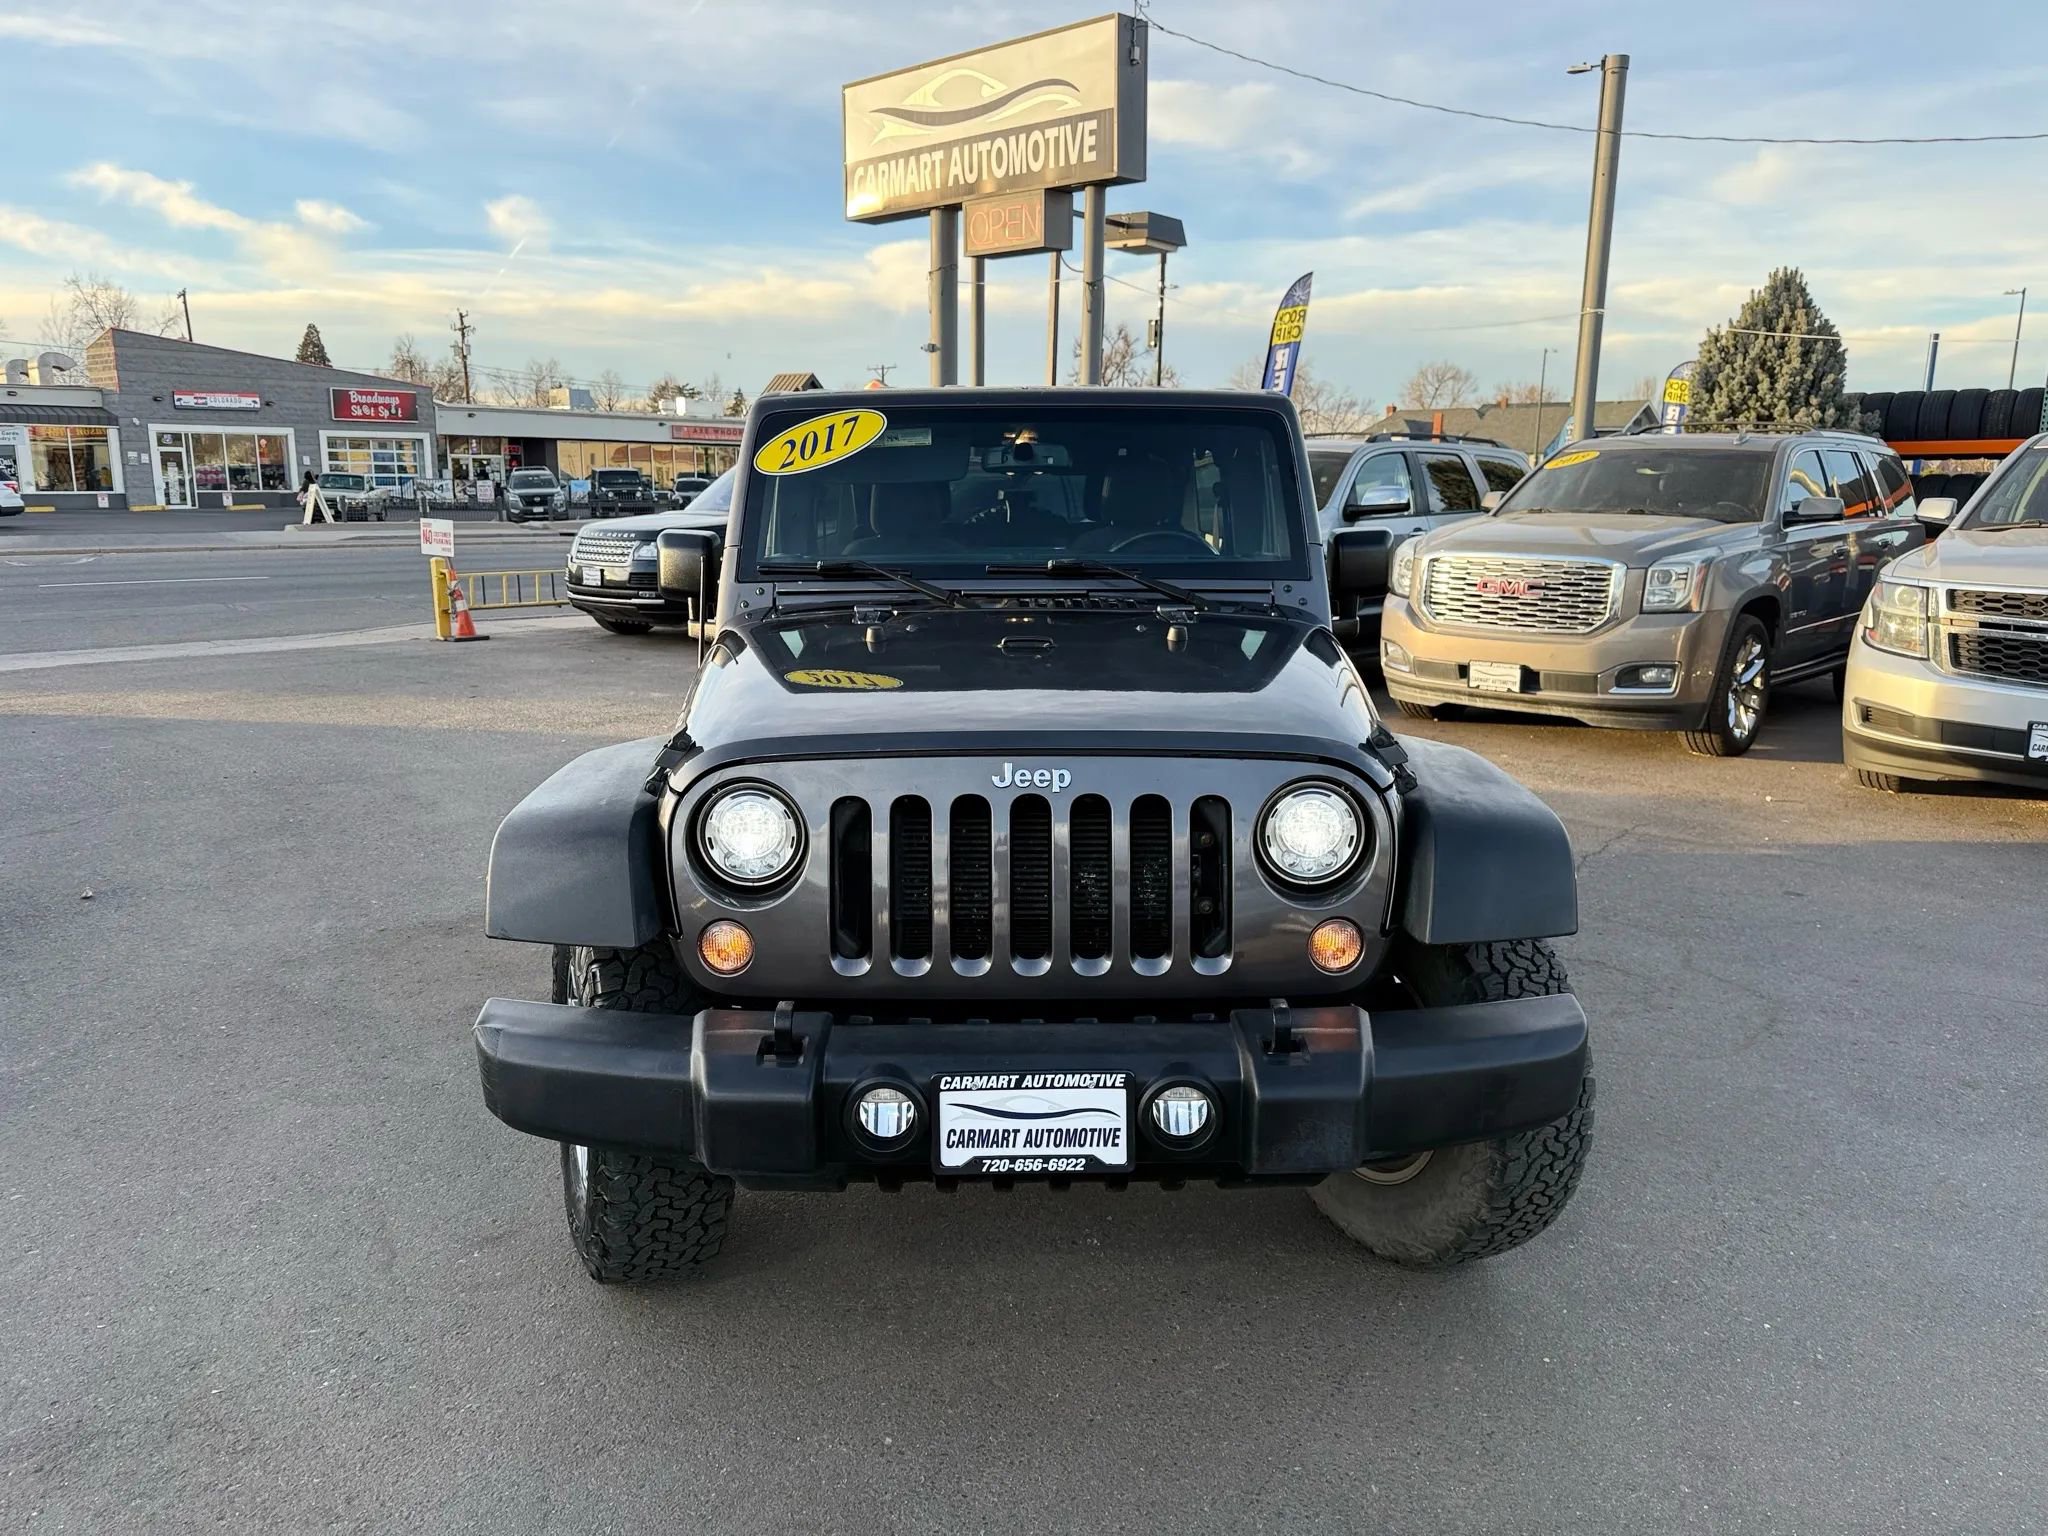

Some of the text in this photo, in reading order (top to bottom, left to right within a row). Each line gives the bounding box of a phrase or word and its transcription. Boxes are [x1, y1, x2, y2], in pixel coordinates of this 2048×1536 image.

[854, 119, 1097, 198] CARMART AUTOMOTIVE
[970, 204, 1041, 245] OPEN
[209, 396, 241, 405] COLORADO
[349, 391, 400, 407] Broadways
[778, 415, 860, 471] 2017
[1476, 577, 1547, 596] GMC
[991, 762, 1072, 793] Jeep
[940, 1073, 1126, 1090] CARMART AUTOMOTIVE
[946, 1127, 1121, 1149] CARMART AUTOMOTIVE
[981, 1158, 1086, 1173] 720-656-6922
